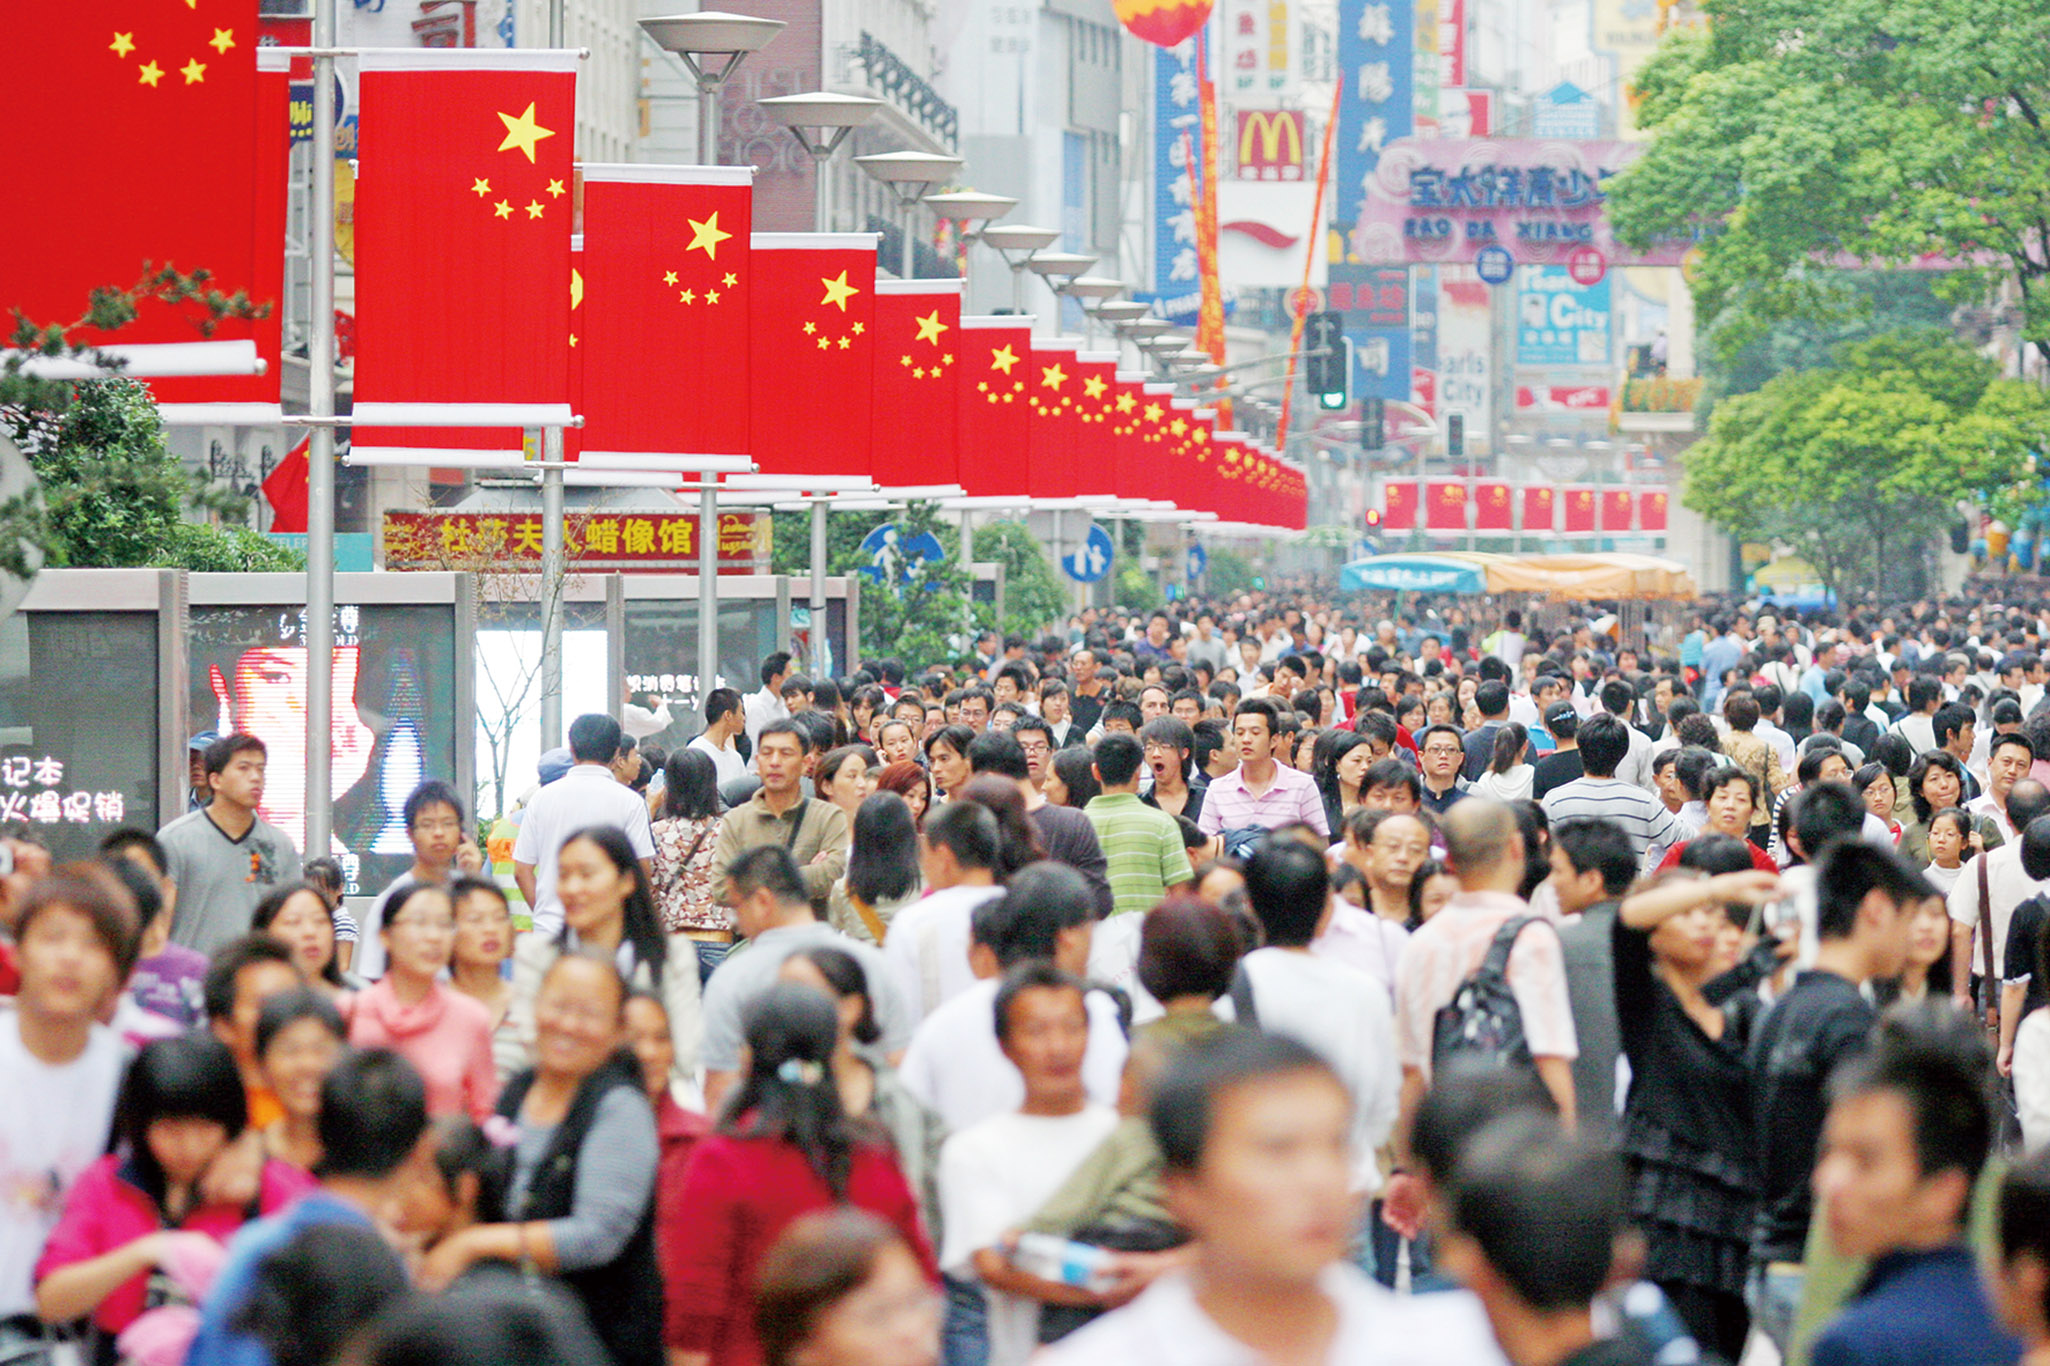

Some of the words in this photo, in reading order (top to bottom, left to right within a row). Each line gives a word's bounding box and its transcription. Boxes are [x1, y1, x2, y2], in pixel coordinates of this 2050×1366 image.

[1550, 292, 1607, 329] City
[2, 755, 64, 788] 记本
[0, 790, 124, 823] 火爆促销
